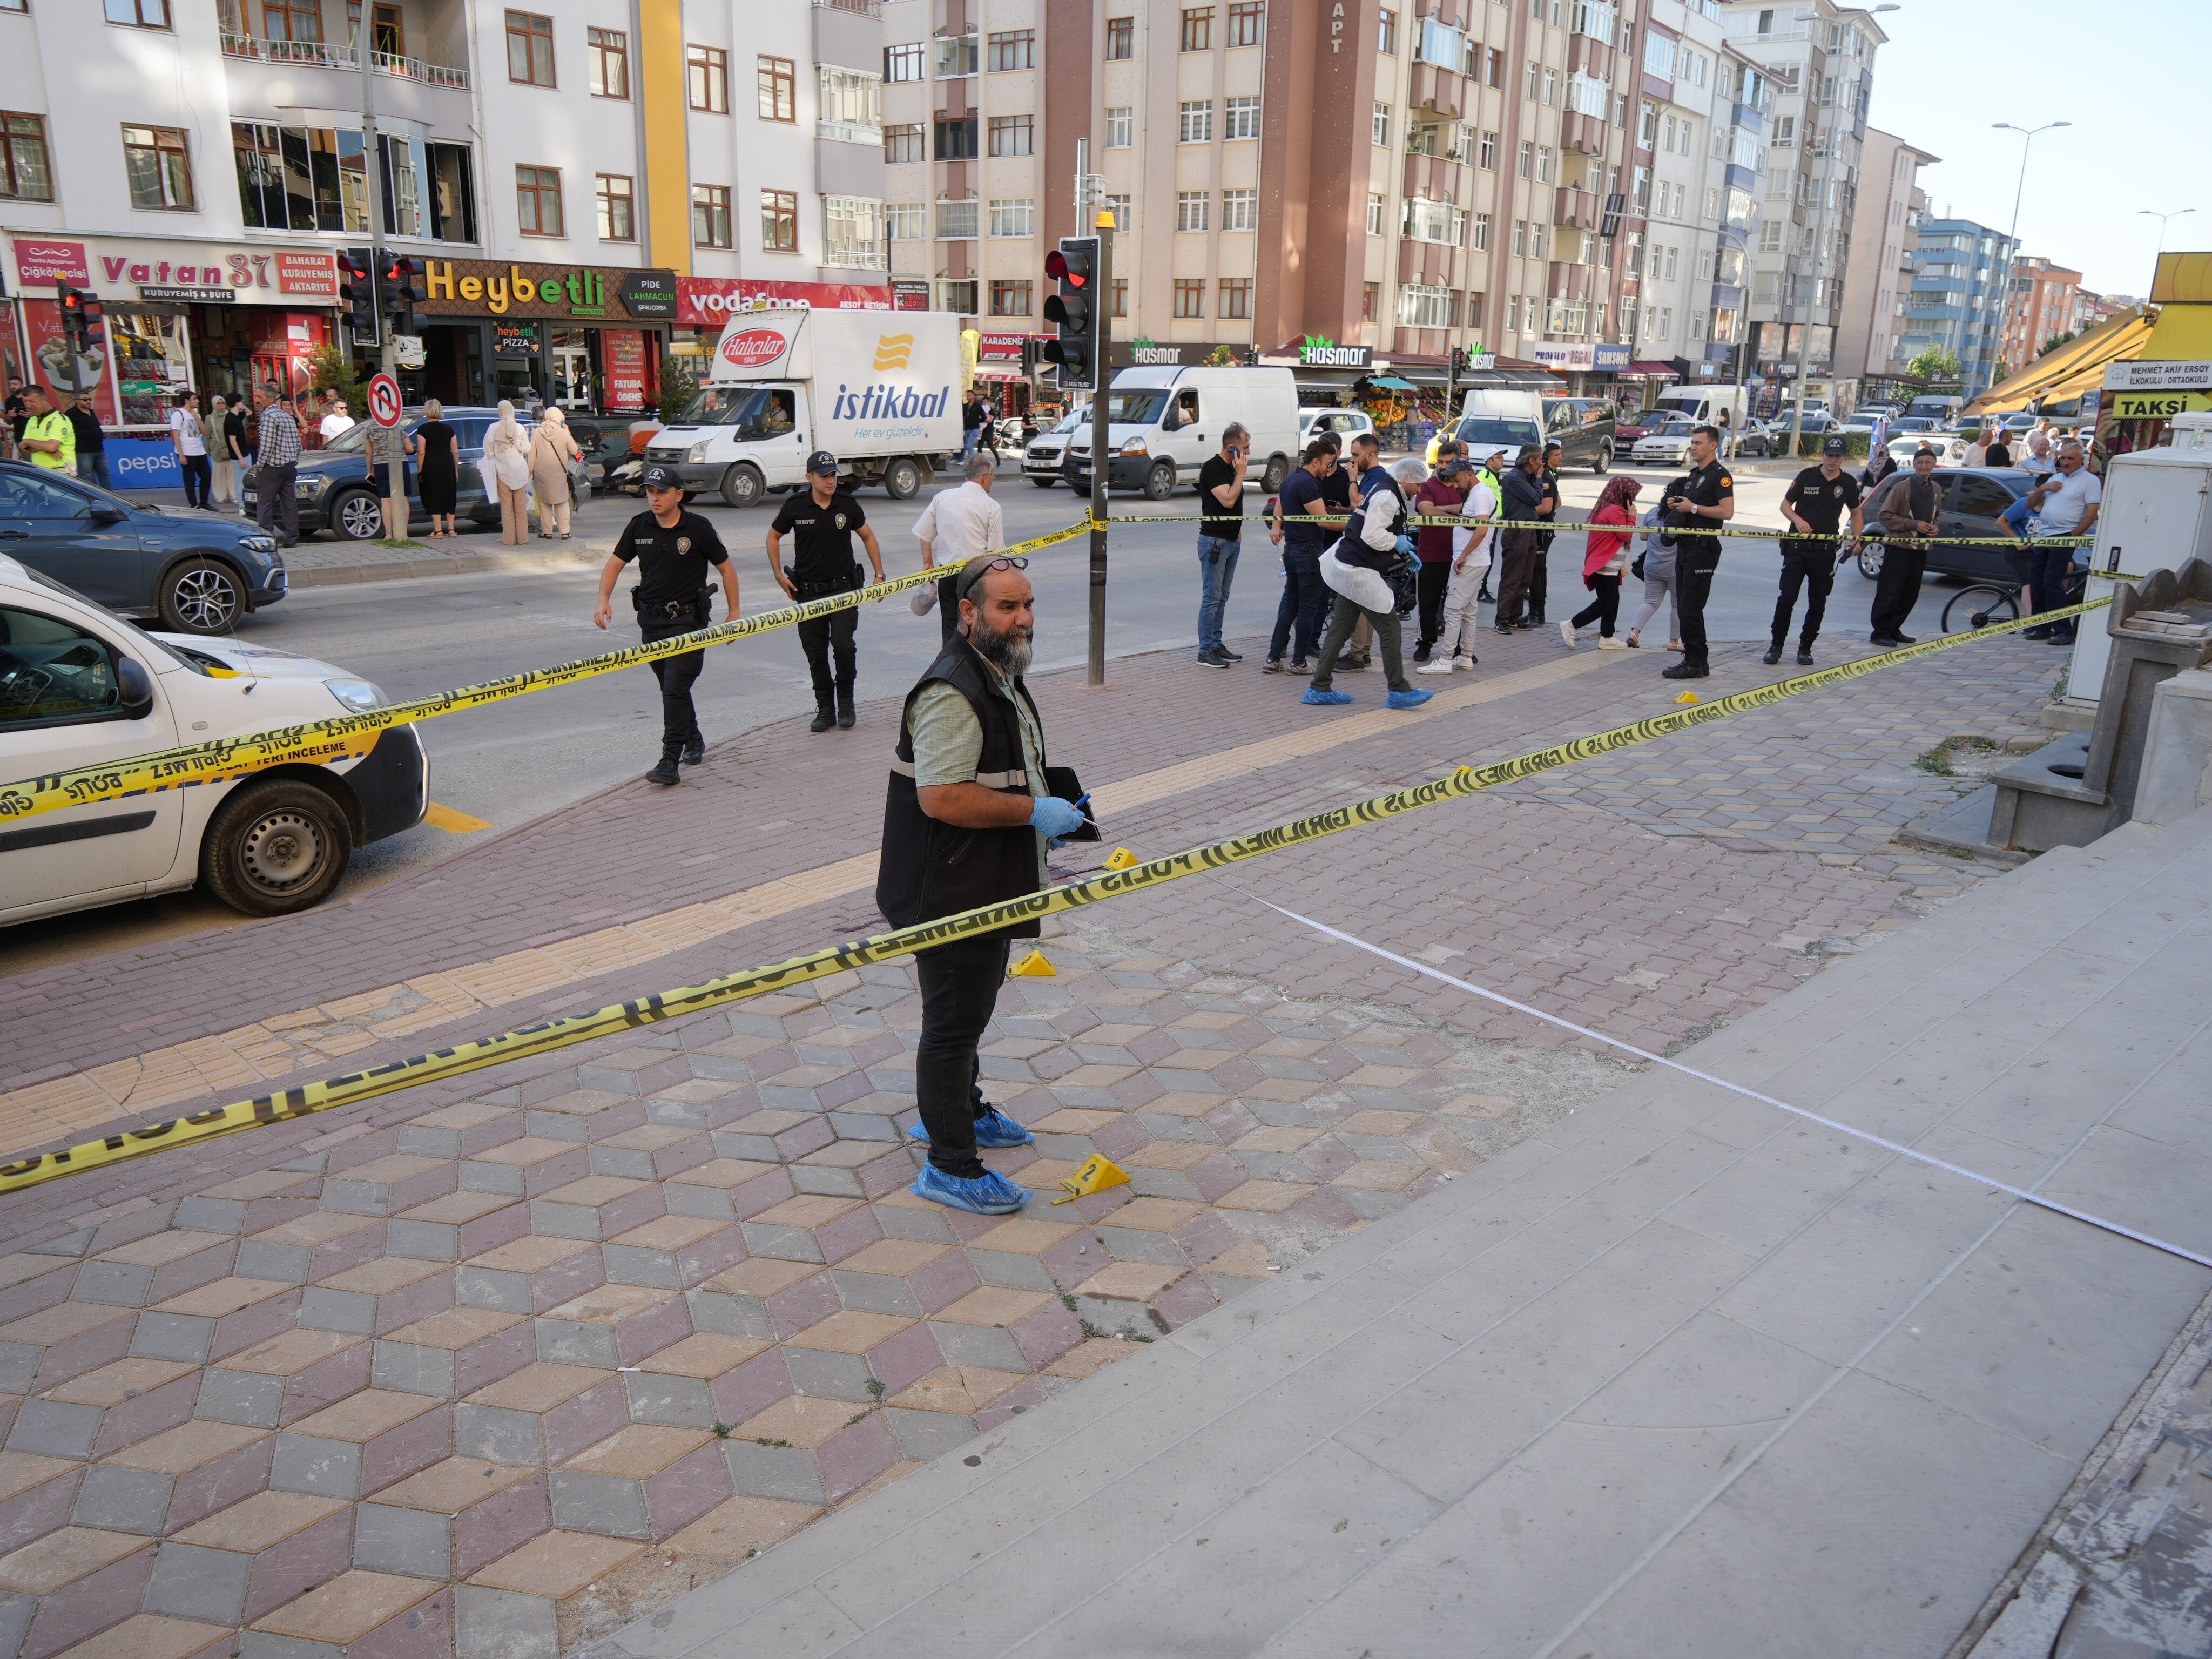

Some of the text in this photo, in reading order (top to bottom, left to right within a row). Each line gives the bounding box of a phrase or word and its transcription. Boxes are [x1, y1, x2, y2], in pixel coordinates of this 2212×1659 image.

[285, 255, 327, 266] BAHARAT
[100, 254, 271, 287] Vatan 37
[282, 268, 333, 281] KURUYEMİŞ
[289, 281, 331, 292] AKTARİYE
[426, 261, 604, 314] Heybetli
[641, 279, 660, 288] PİDE
[144, 288, 198, 299] KURUYEMİŞ
[210, 289, 232, 299] BÜFE
[629, 293, 674, 301] LAHMACUN
[840, 300, 889, 311] AKSOY İLETİŞİM
[497, 326, 534, 338] heybetli
[503, 336, 529, 347] PİZZA
[724, 335, 785, 356] Halıcılar
[1596, 350, 1629, 366] SAMSUNG
[2164, 365, 2183, 374] AKİF
[2184, 365, 2210, 373] ERSOY
[613, 380, 643, 389] FATURA
[2129, 376, 2162, 385] İLKOKULU
[617, 391, 642, 402] ÖDEME
[832, 383, 950, 420] istikbal
[2121, 395, 2188, 415] TAKSİ
[854, 426, 924, 440] Her ev güzeldir
[118, 453, 177, 475] pepsi
[759, 609, 793, 628] POLİS
[807, 594, 854, 616] GİRİLMEZ
[865, 585, 893, 601] POLİS
[1113, 853, 1123, 863] 5
[1081, 1163, 1096, 1182] 2
